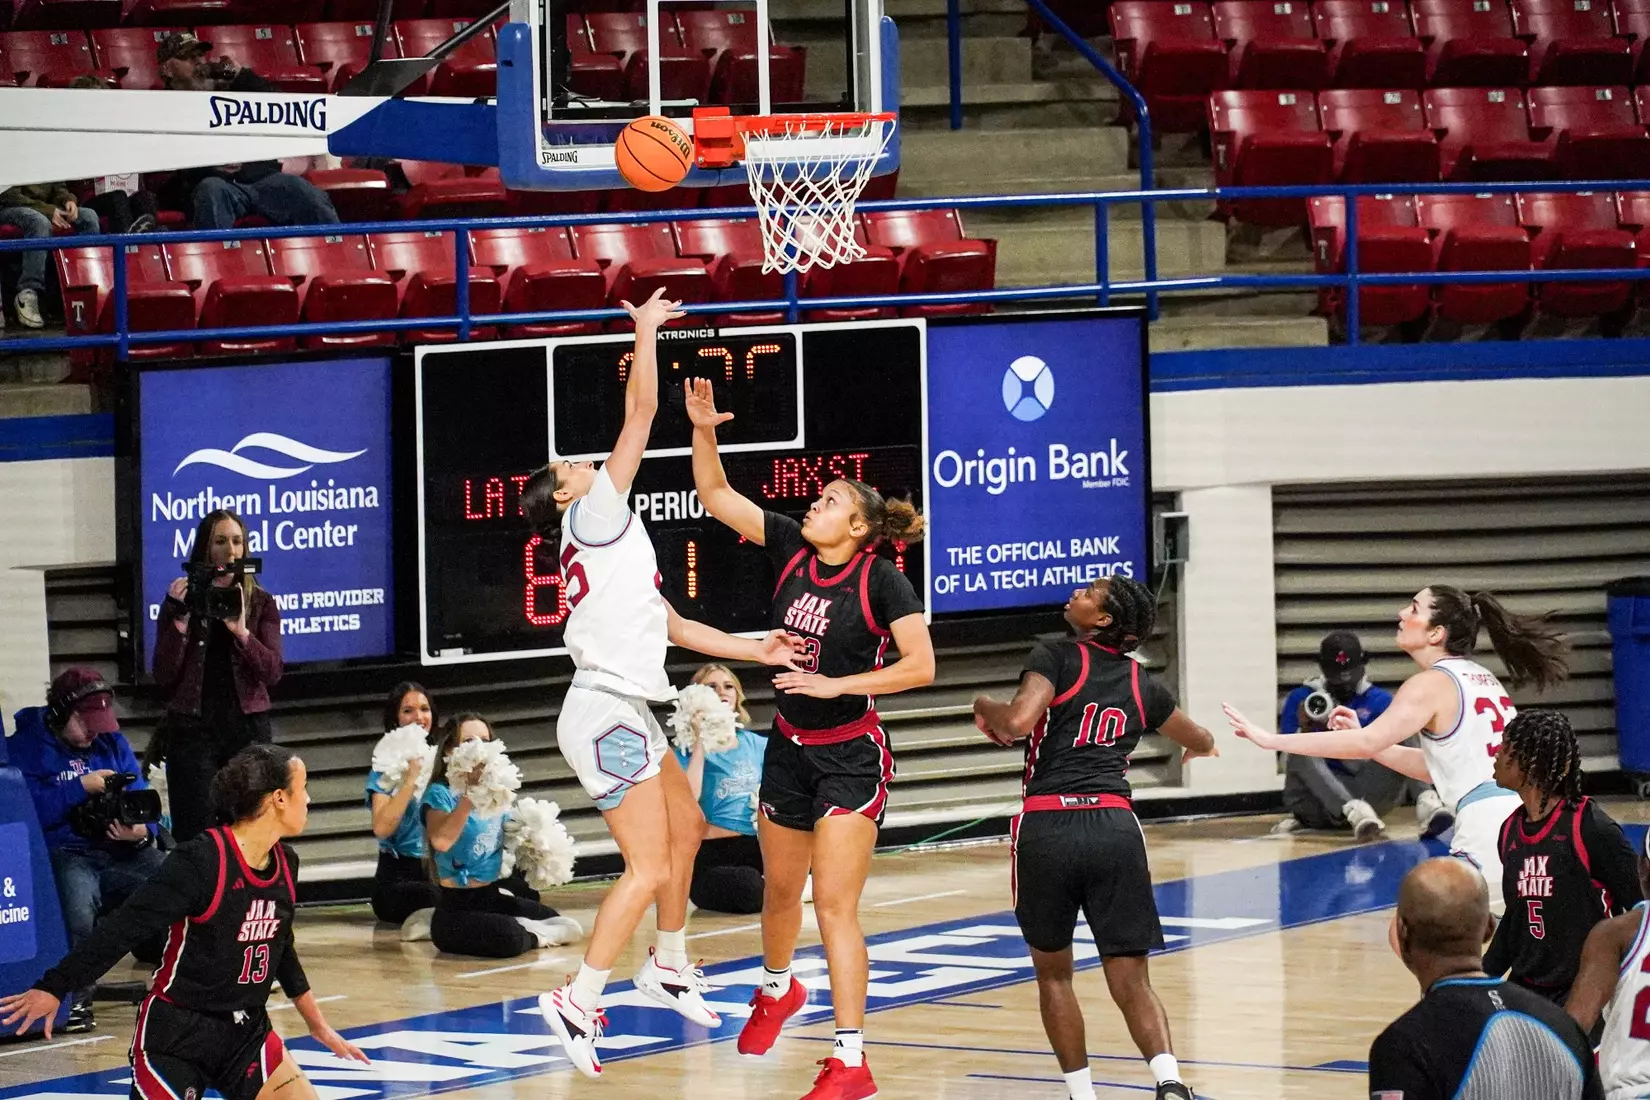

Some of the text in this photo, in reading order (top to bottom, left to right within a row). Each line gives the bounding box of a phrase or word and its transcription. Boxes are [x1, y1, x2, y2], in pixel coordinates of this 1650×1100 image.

[210, 95, 327, 131] SPALDING
[542, 150, 578, 165] SPALDING
[651, 121, 692, 160] Wilson
[933, 437, 1130, 494] Origin Bank
[152, 478, 379, 521] Northern Louisiana
[634, 489, 714, 521] PERIO
[275, 519, 358, 550] Center
[947, 536, 1120, 566] THE OFFICIAL BANK
[687, 541, 697, 598] 1
[934, 560, 1134, 594] OF LA TECH ATHLETICS
[301, 588, 384, 609] PROVIDER
[792, 592, 832, 617] JAX
[783, 607, 831, 636] STATE
[1072, 702, 1127, 748] 10
[237, 919, 281, 942] STATE
[1526, 900, 1546, 940] 5
[237, 943, 270, 984] 13
